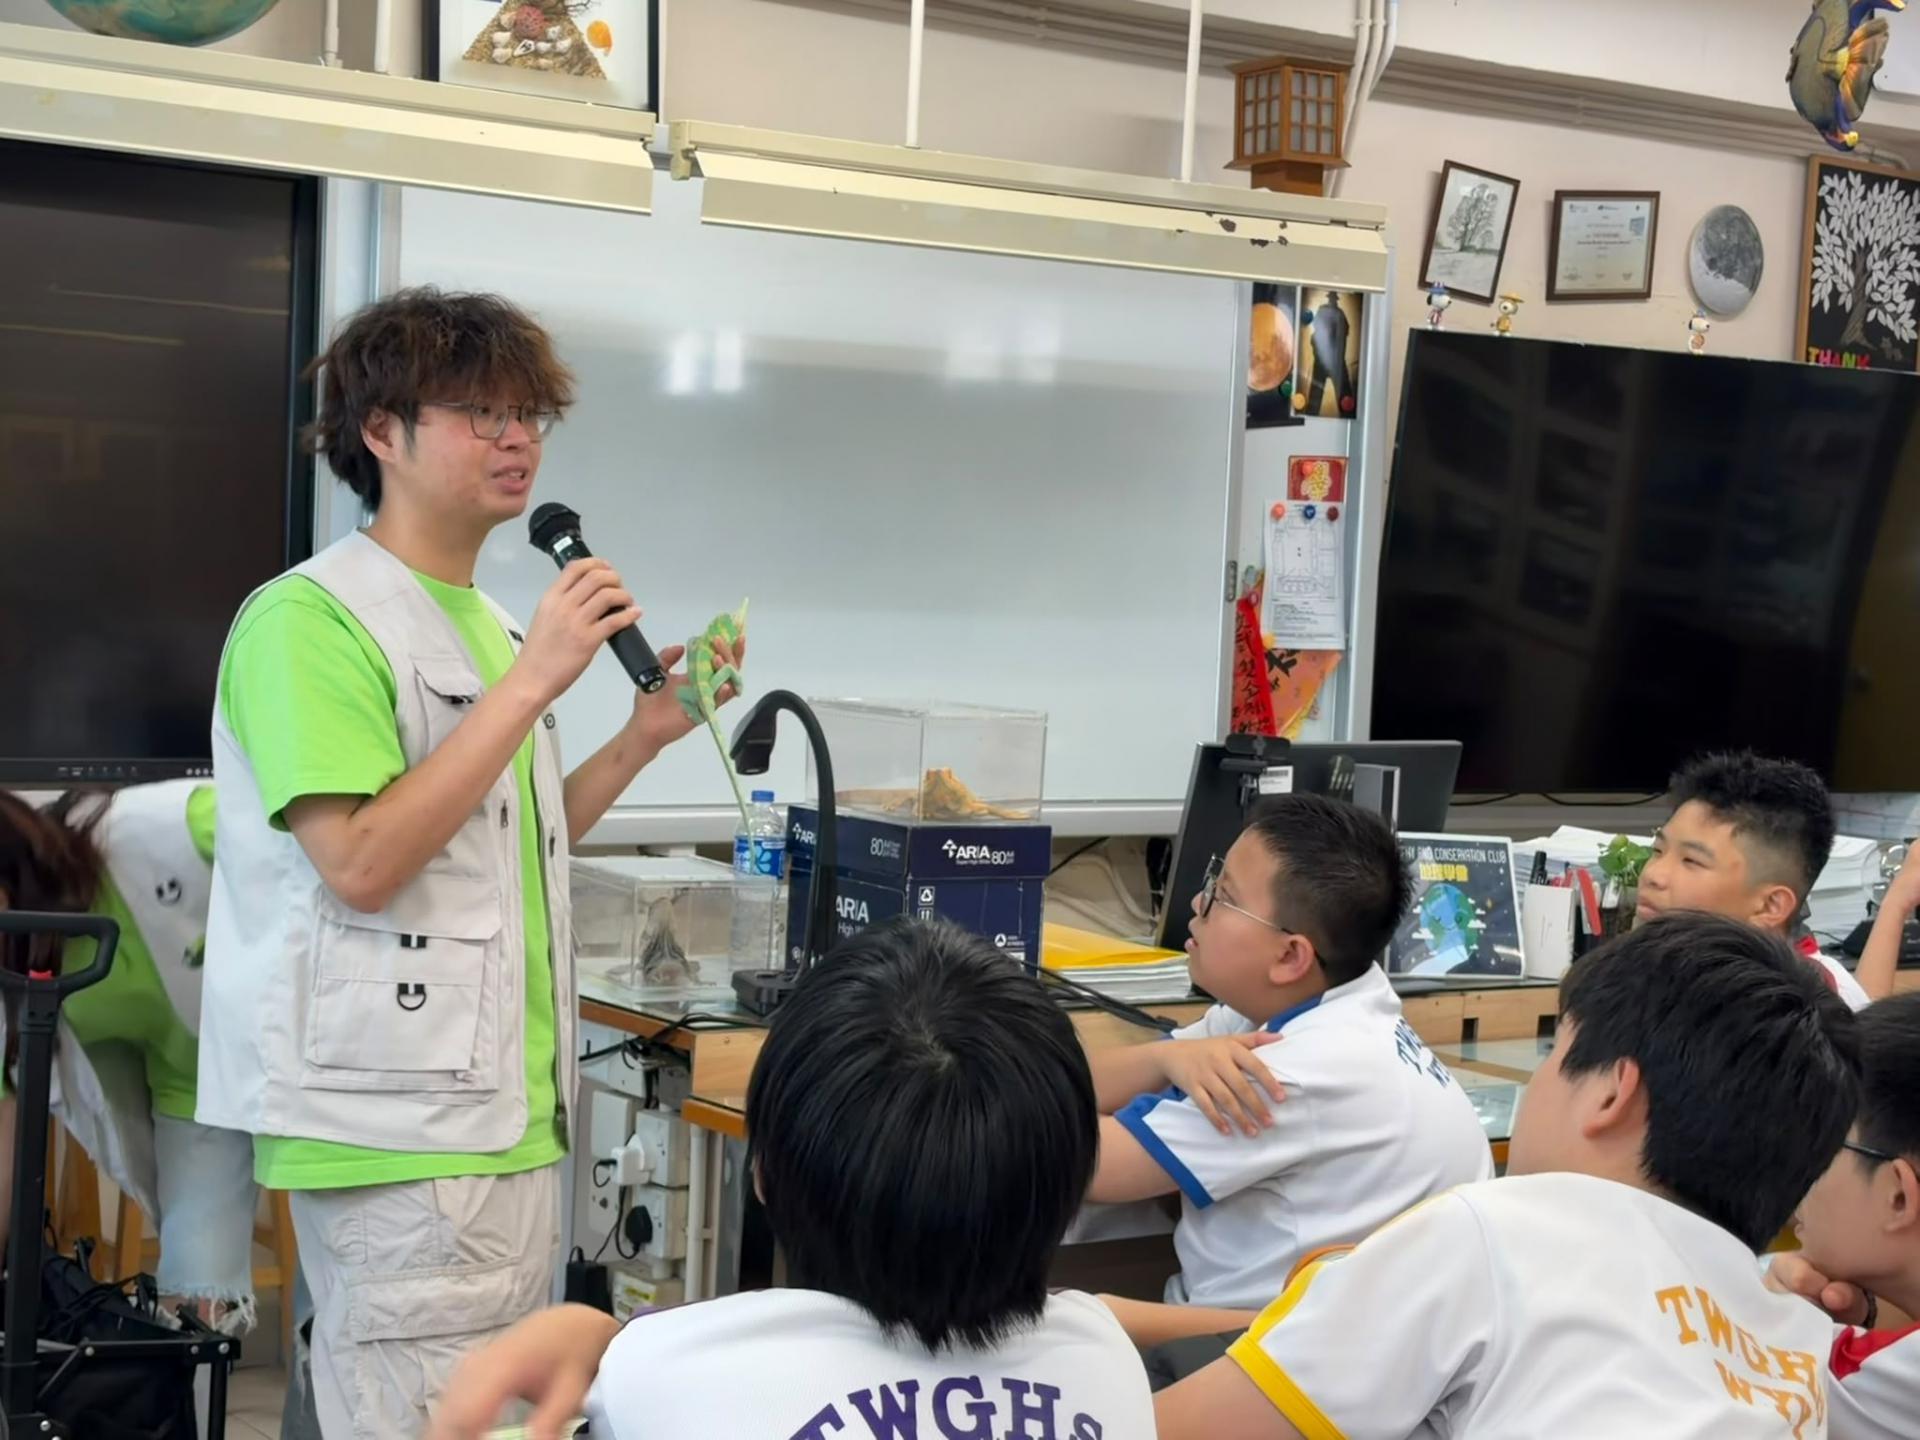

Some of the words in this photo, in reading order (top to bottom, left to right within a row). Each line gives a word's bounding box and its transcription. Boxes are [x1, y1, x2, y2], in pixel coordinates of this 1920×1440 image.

[1808, 346, 1870, 369] THANK
[870, 837, 884, 856] 80
[956, 845, 990, 859] ARIA
[991, 851, 1007, 865] 80
[1434, 847, 1486, 862] CONSERVATION
[1488, 849, 1506, 864] CLUB
[836, 895, 870, 923] ARIA
